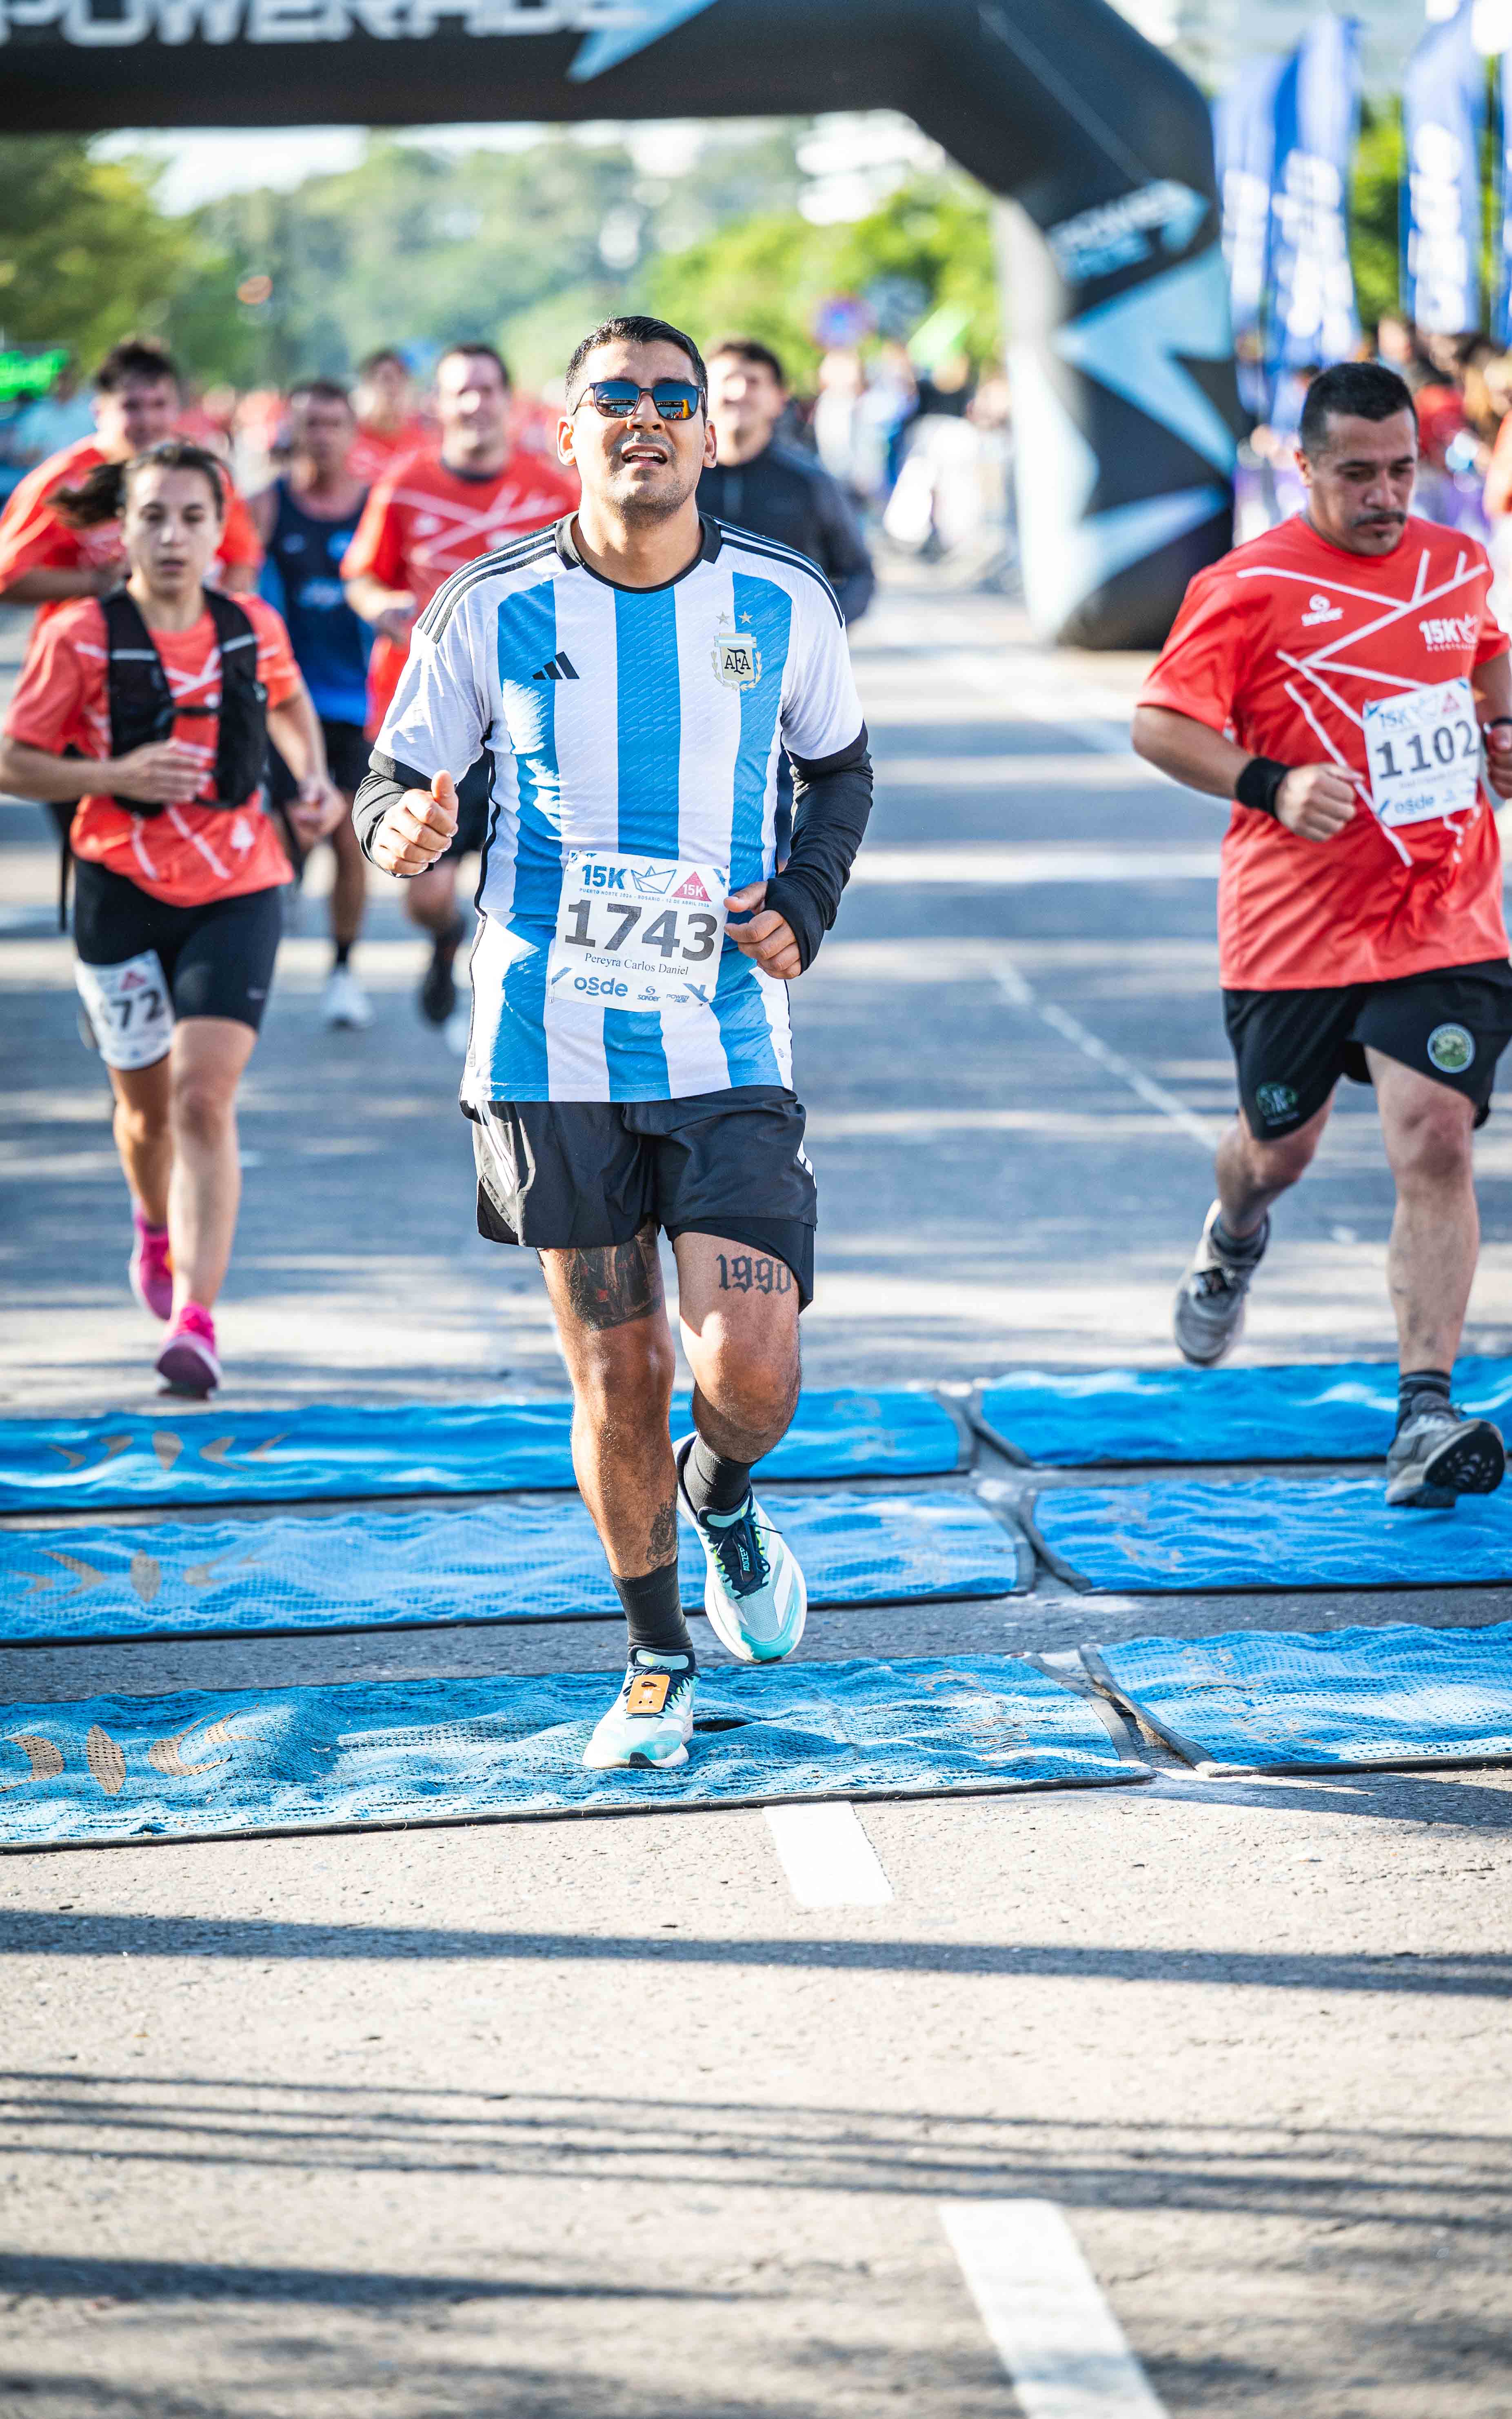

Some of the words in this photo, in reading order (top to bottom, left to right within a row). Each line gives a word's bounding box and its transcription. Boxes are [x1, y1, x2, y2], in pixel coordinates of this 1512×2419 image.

[724, 647, 751, 674] AFA
[1375, 720, 1480, 779] 1102
[582, 864, 627, 890] 15K
[683, 884, 704, 897] 15K
[565, 899, 718, 962] 1743
[584, 953, 621, 967] Pereyra
[624, 959, 656, 972] Carlos
[658, 964, 689, 975] Daniel
[574, 977, 628, 997] osde
[716, 1254, 791, 1295] 1990
